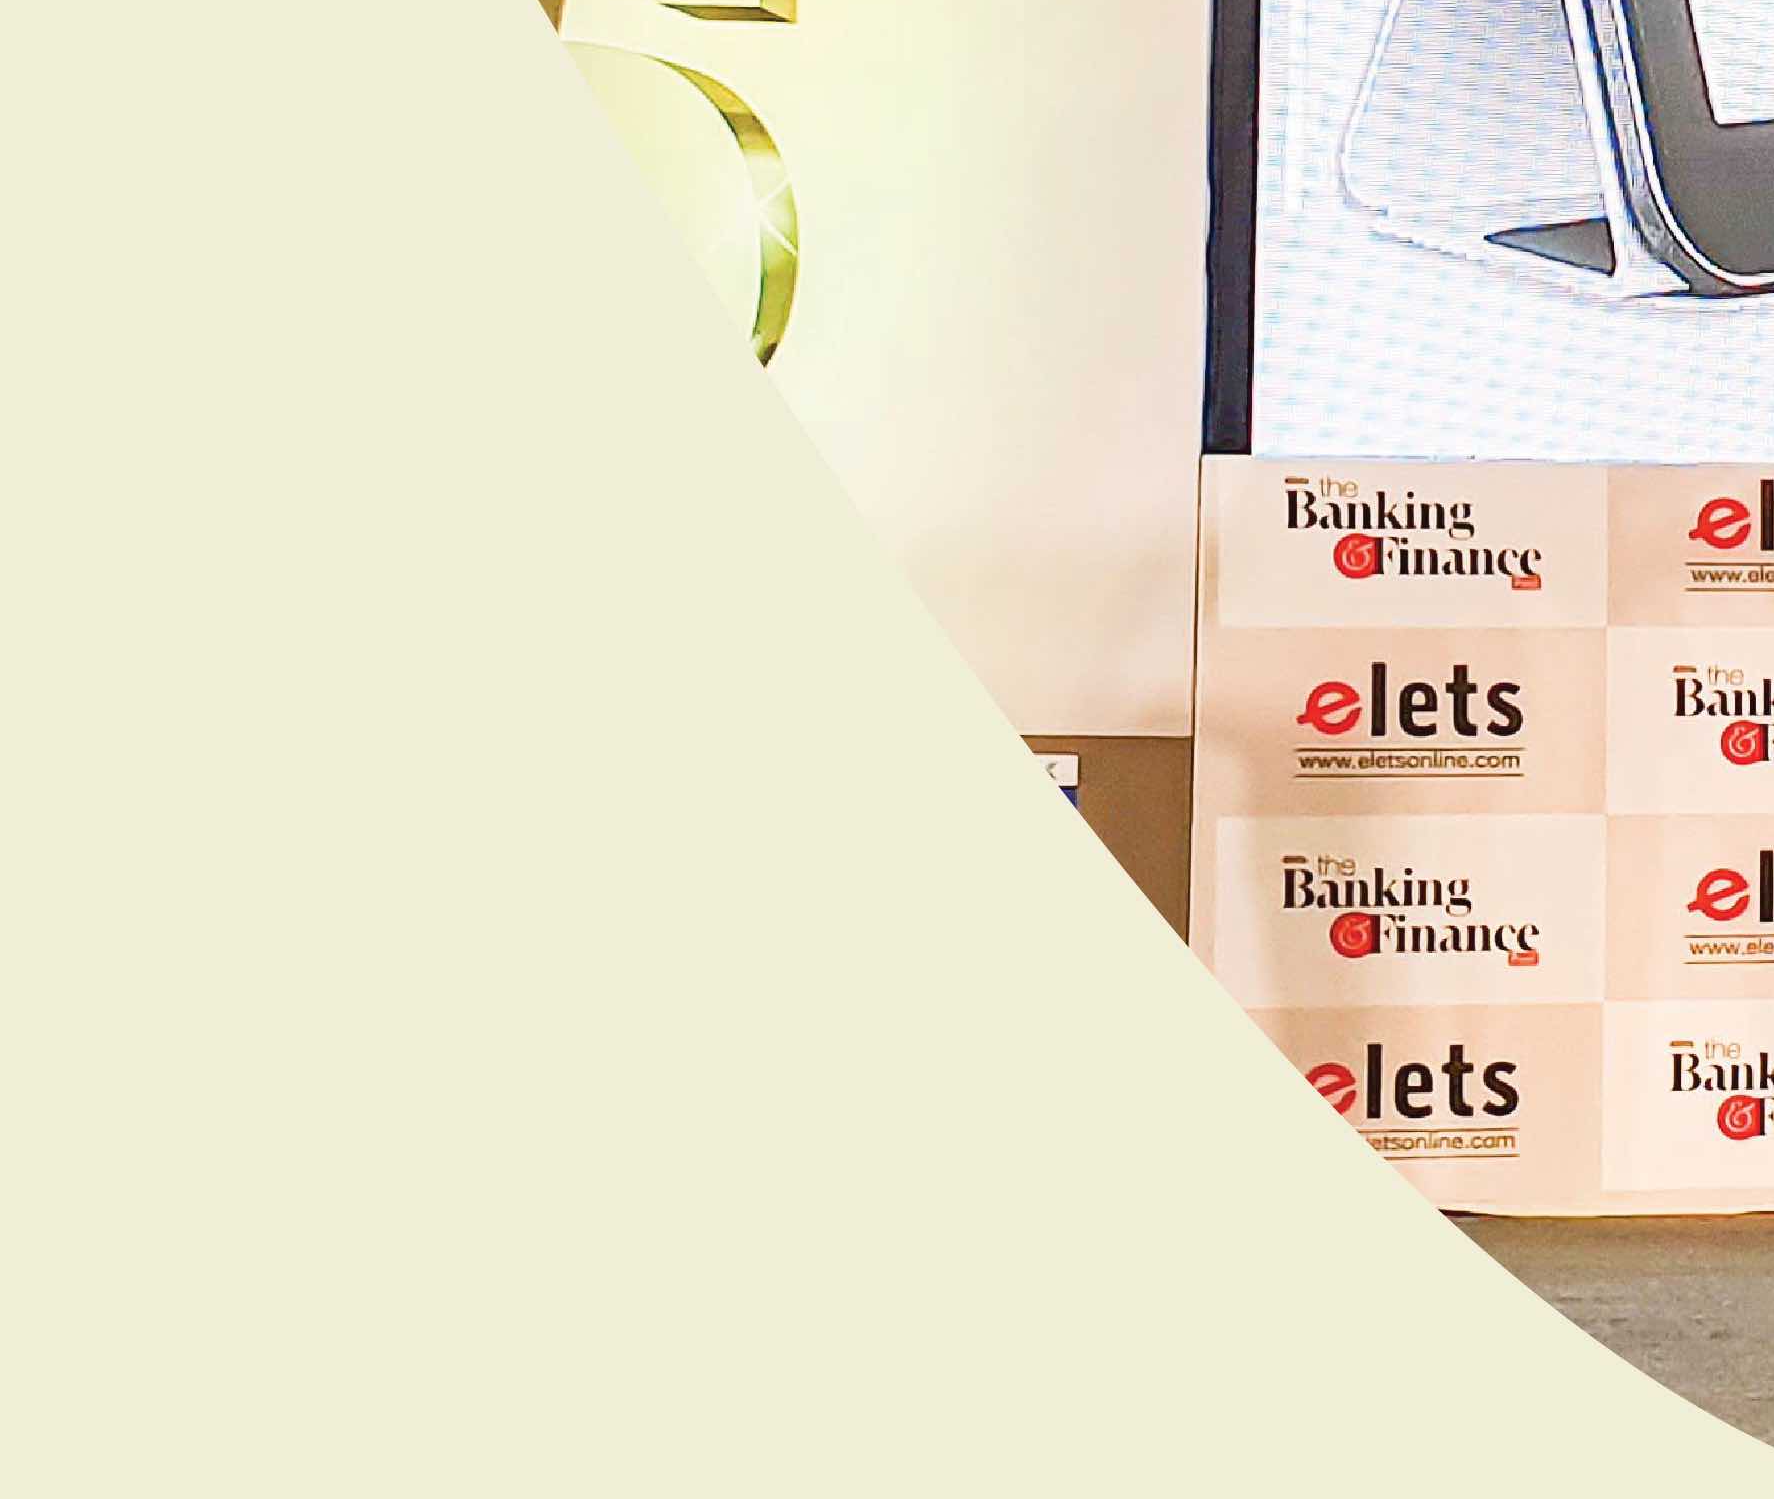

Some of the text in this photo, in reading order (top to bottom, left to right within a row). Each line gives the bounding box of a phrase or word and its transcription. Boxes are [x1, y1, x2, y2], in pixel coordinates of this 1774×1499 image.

[1286, 489, 1474, 539] Banking
[1297, 662, 1523, 736] elets
[1299, 752, 1520, 771] www.eletsonline.com
[1283, 868, 1471, 916] Banking
